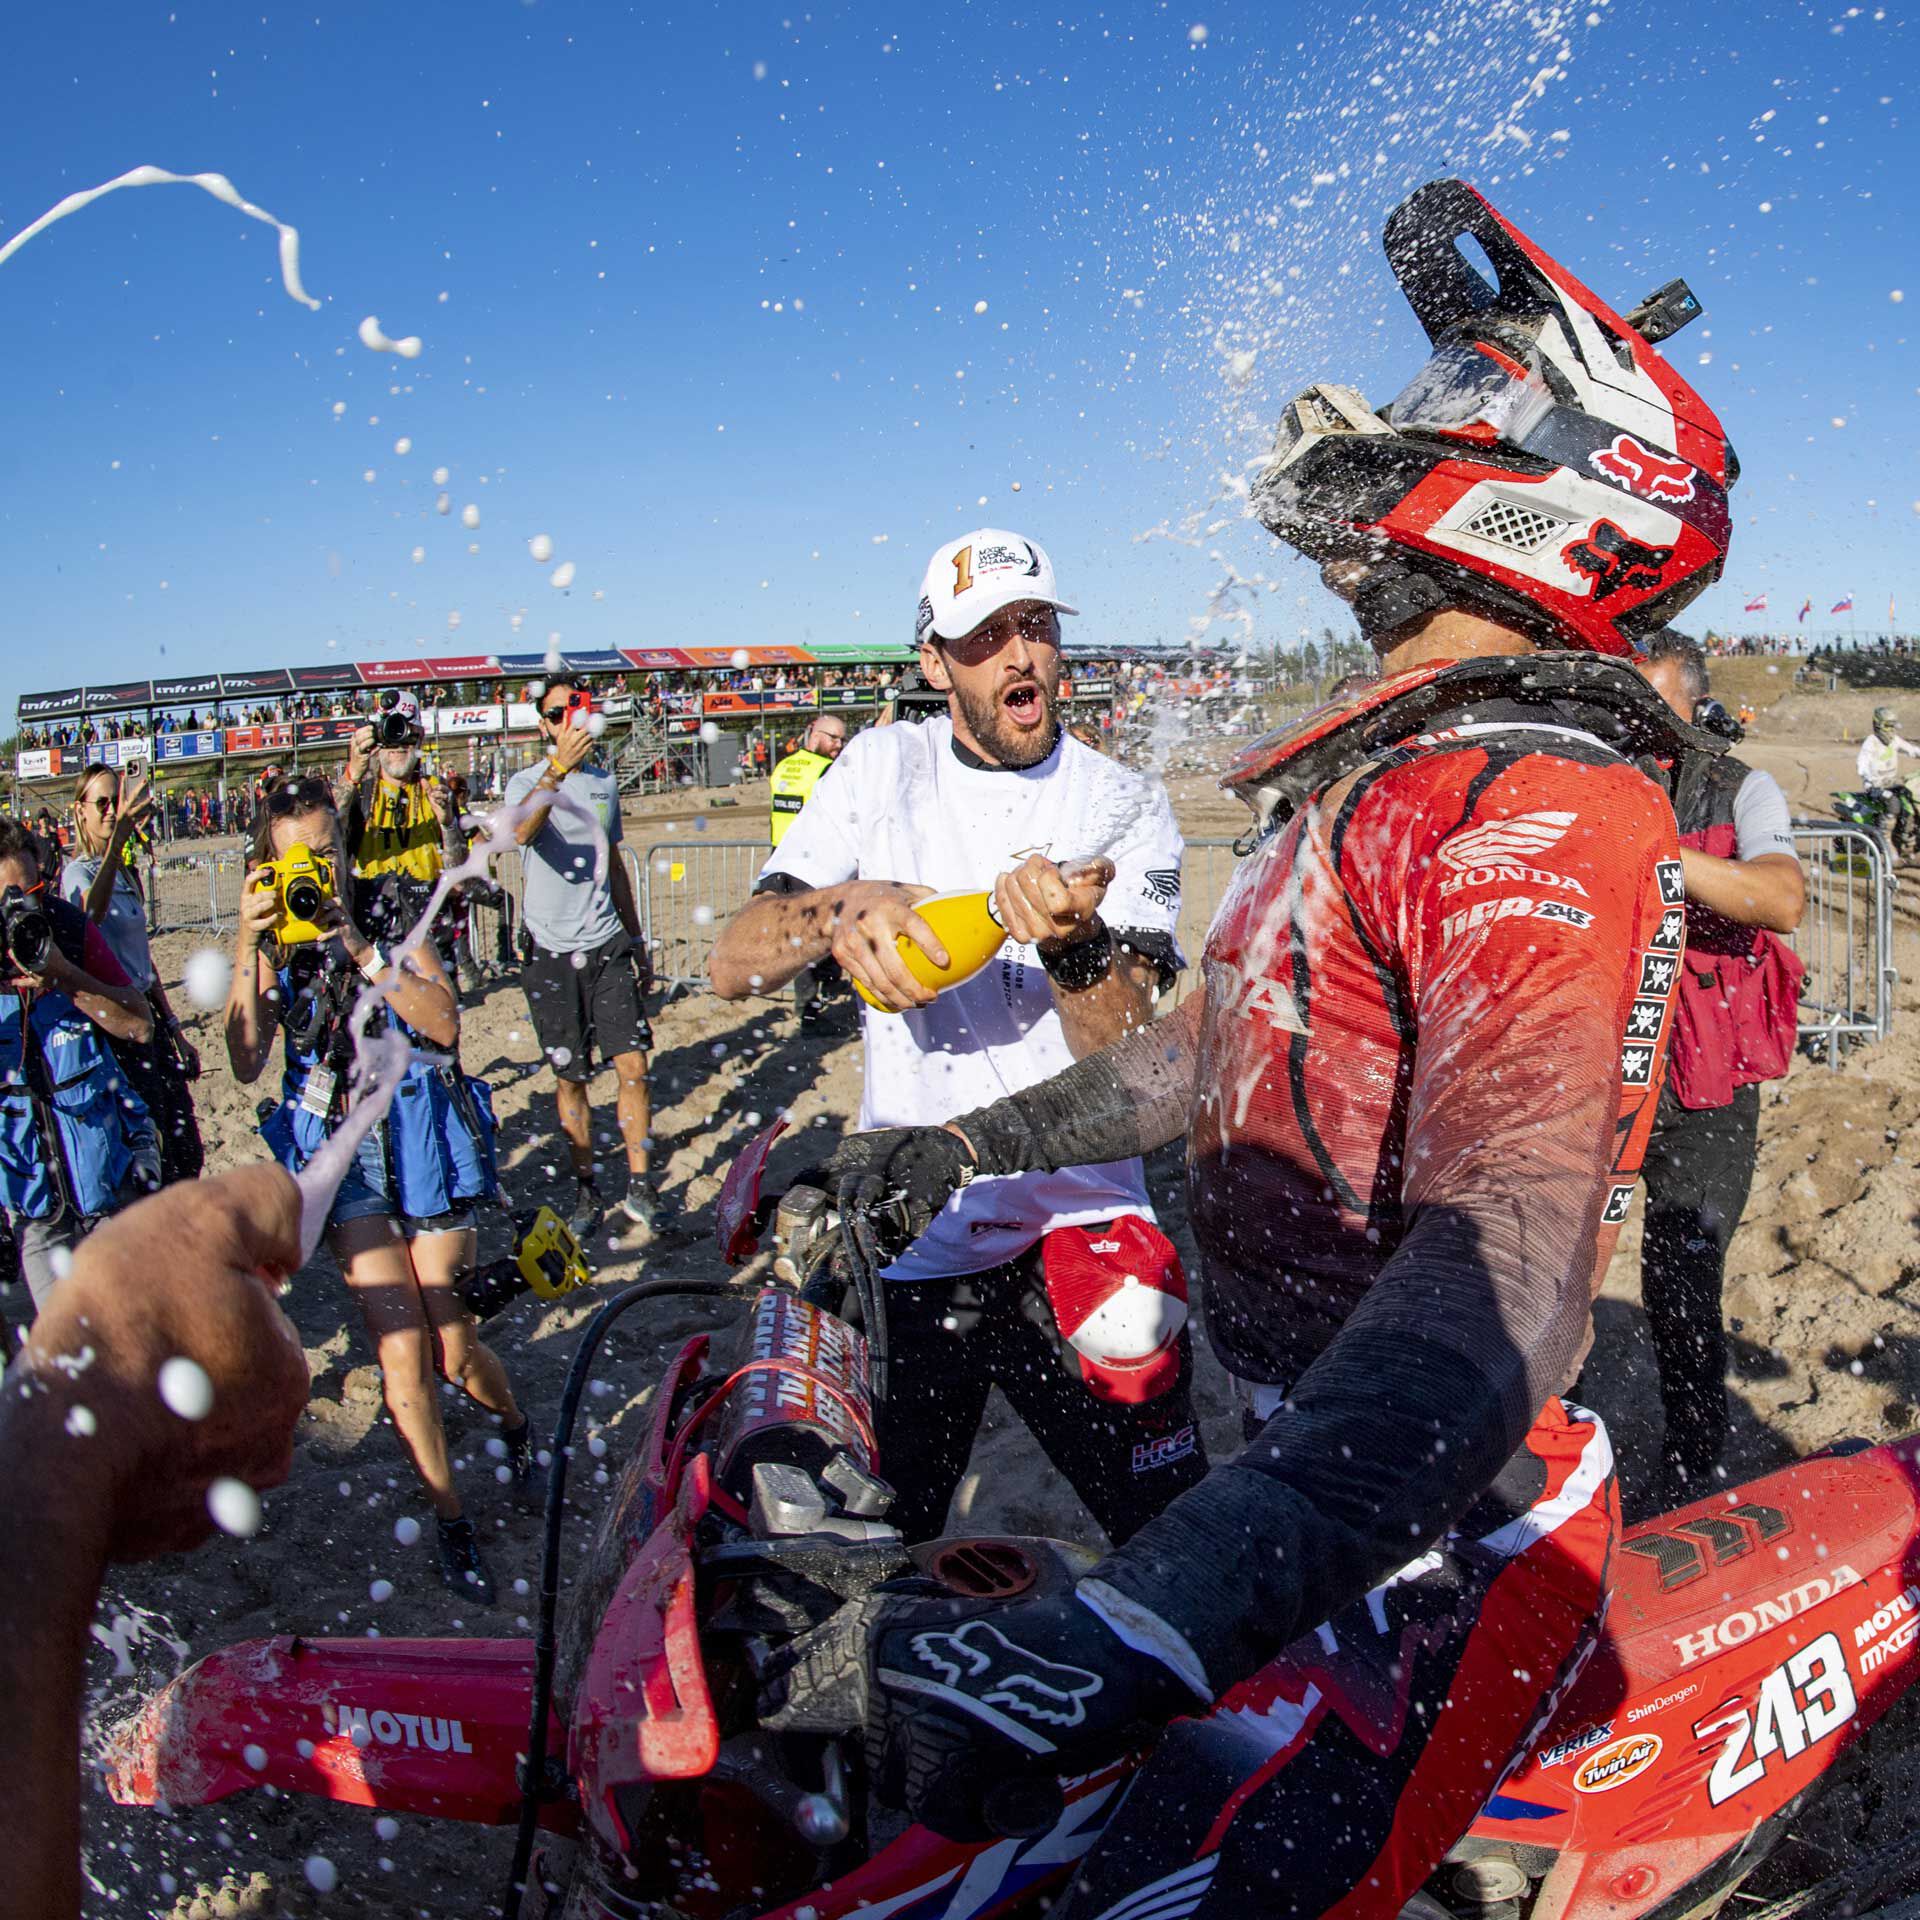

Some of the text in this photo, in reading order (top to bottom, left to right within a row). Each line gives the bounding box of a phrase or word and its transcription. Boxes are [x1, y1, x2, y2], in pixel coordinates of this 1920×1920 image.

[952, 545, 974, 597] 1
[452, 710, 489, 725] HRC
[1437, 865, 1591, 900] HONDA
[1131, 1425, 1194, 1470] HRC
[1672, 1564, 1864, 1667] HONDA
[1626, 1682, 1698, 1723] ShinDengen
[1692, 1632, 1858, 1809] 243
[338, 1705, 472, 1754] MOTUL
[1538, 1720, 1616, 1767] VERTEX
[1584, 1755, 1626, 1786] Twin
[1627, 1741, 1656, 1766] Air
